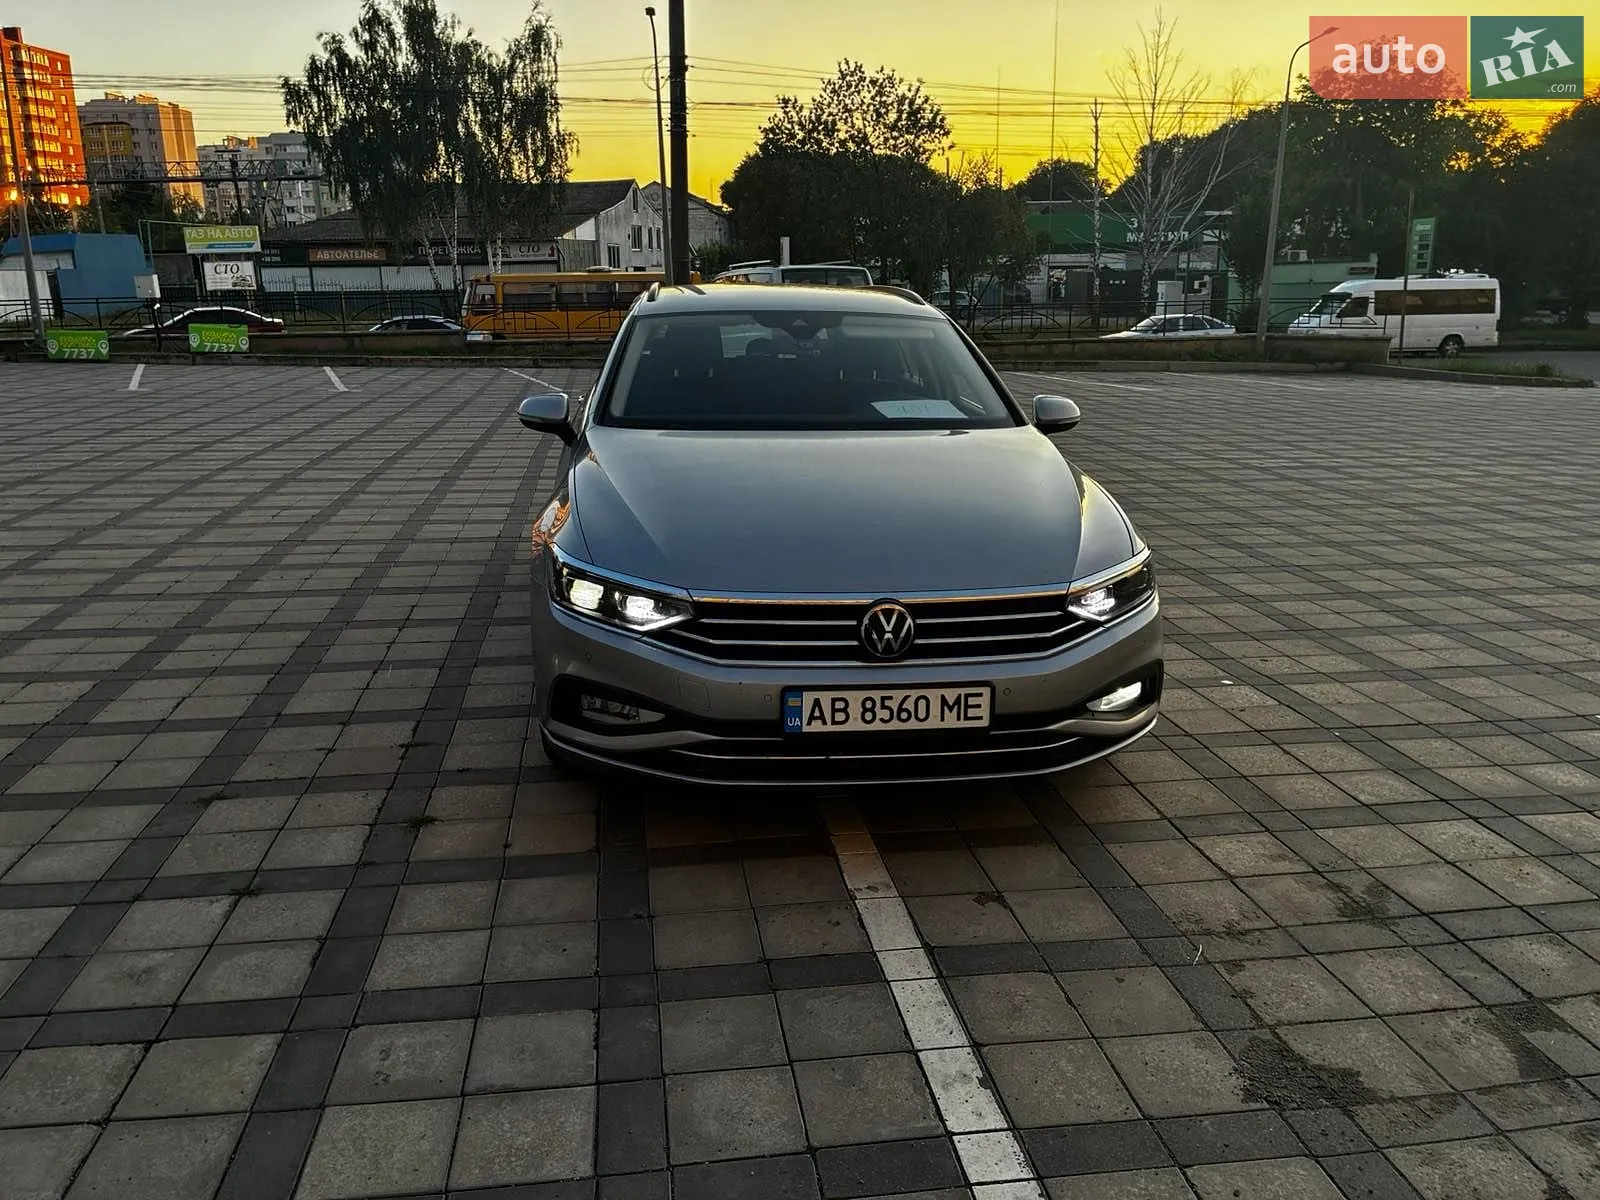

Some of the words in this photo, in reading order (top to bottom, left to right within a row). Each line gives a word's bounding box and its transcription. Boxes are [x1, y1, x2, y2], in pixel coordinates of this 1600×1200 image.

[185, 229, 205, 239] ГАЗ
[207, 228, 222, 239] НА
[223, 227, 253, 238] АВТО
[316, 247, 380, 260] АВТОАТЕЛЬЕ
[519, 243, 540, 254] СТО
[214, 263, 240, 275] СТО
[62, 348, 96, 359] 7737
[203, 342, 236, 353] 7737
[862, 604, 914, 657] VW
[805, 697, 850, 726] AB
[860, 694, 931, 725] 8560
[939, 692, 984, 722] ME
[787, 717, 801, 726] UA
